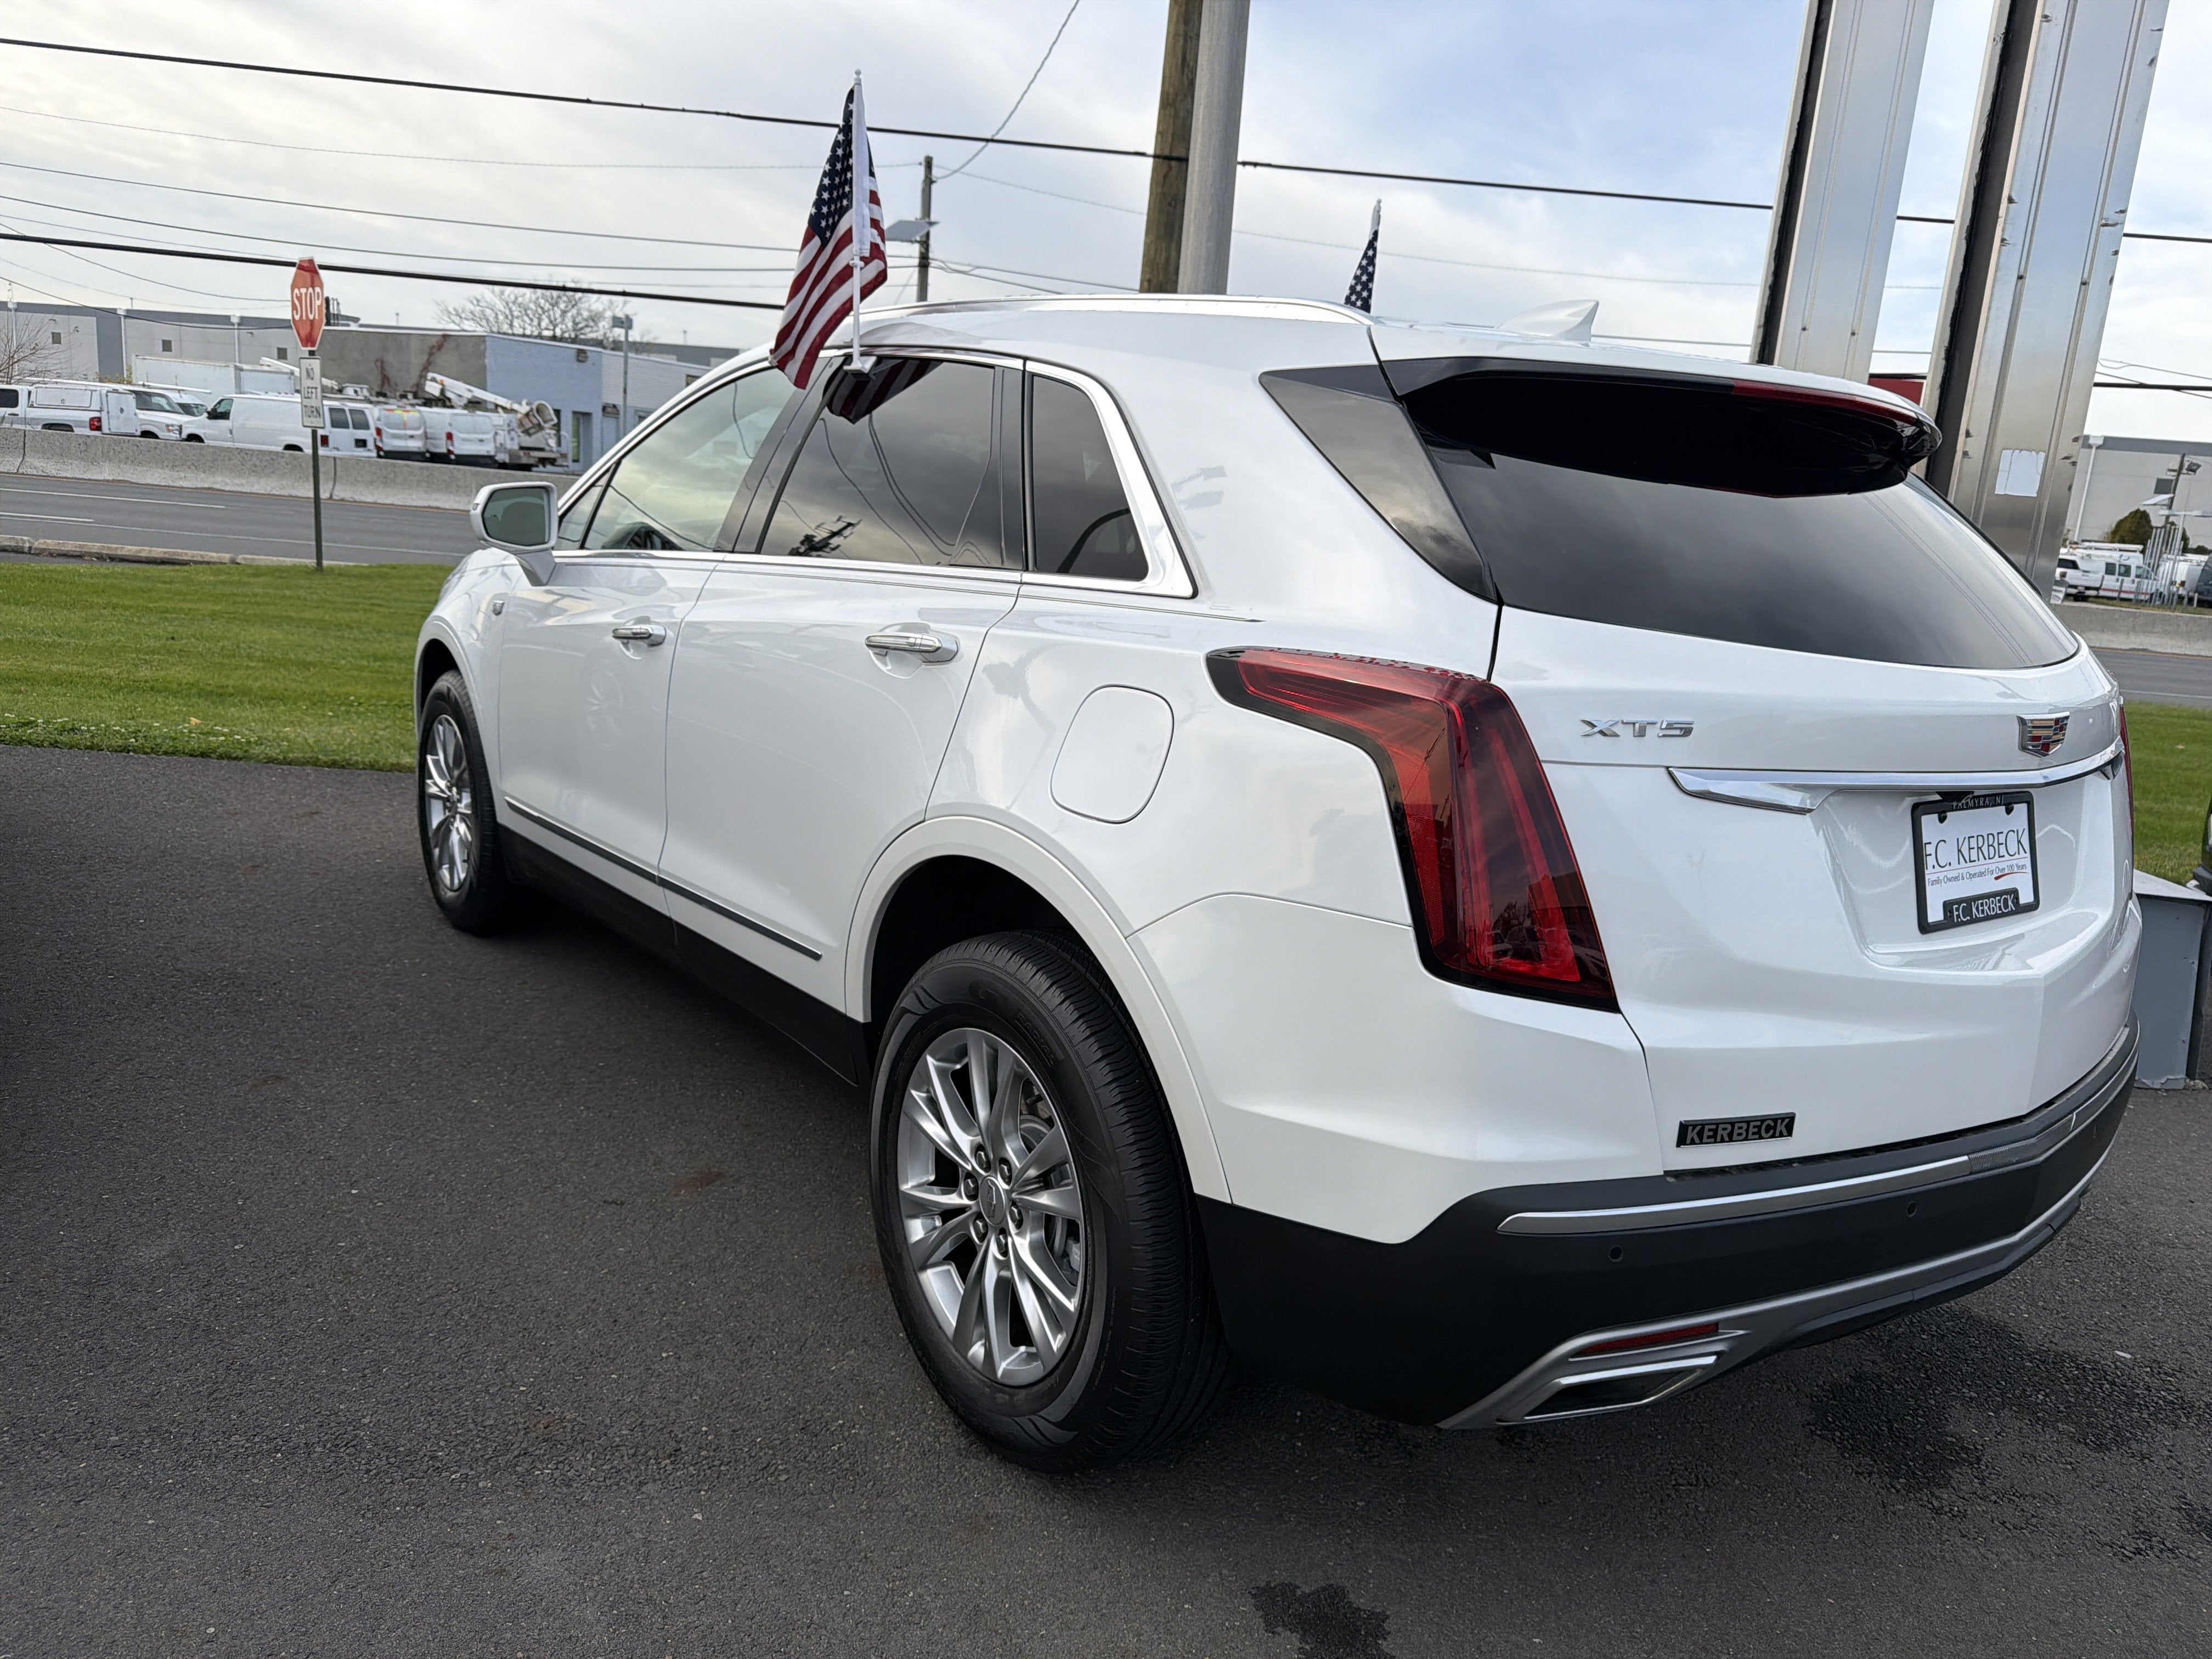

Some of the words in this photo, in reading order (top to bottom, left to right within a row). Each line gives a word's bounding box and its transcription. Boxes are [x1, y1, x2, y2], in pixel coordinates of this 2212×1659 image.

[292, 287, 321, 320] STOP
[306, 367, 314, 380] NO
[303, 386, 318, 399] LEFT
[303, 405, 321, 419] TURN
[1580, 718, 1695, 737] XT5
[1924, 839, 1951, 870] F.C.
[1957, 828, 2028, 865] KERBECK
[1928, 876, 1943, 887] Family
[1943, 874, 1960, 884] Owned
[1966, 870, 1987, 881] Operated
[1995, 866, 2006, 874] Over
[2006, 865, 2015, 873] 100
[2015, 863, 2028, 871] Years
[1953, 905, 1971, 923] F.C.
[1972, 894, 2015, 918] KERBECK
[1685, 1118, 1790, 1144] KERBECK
